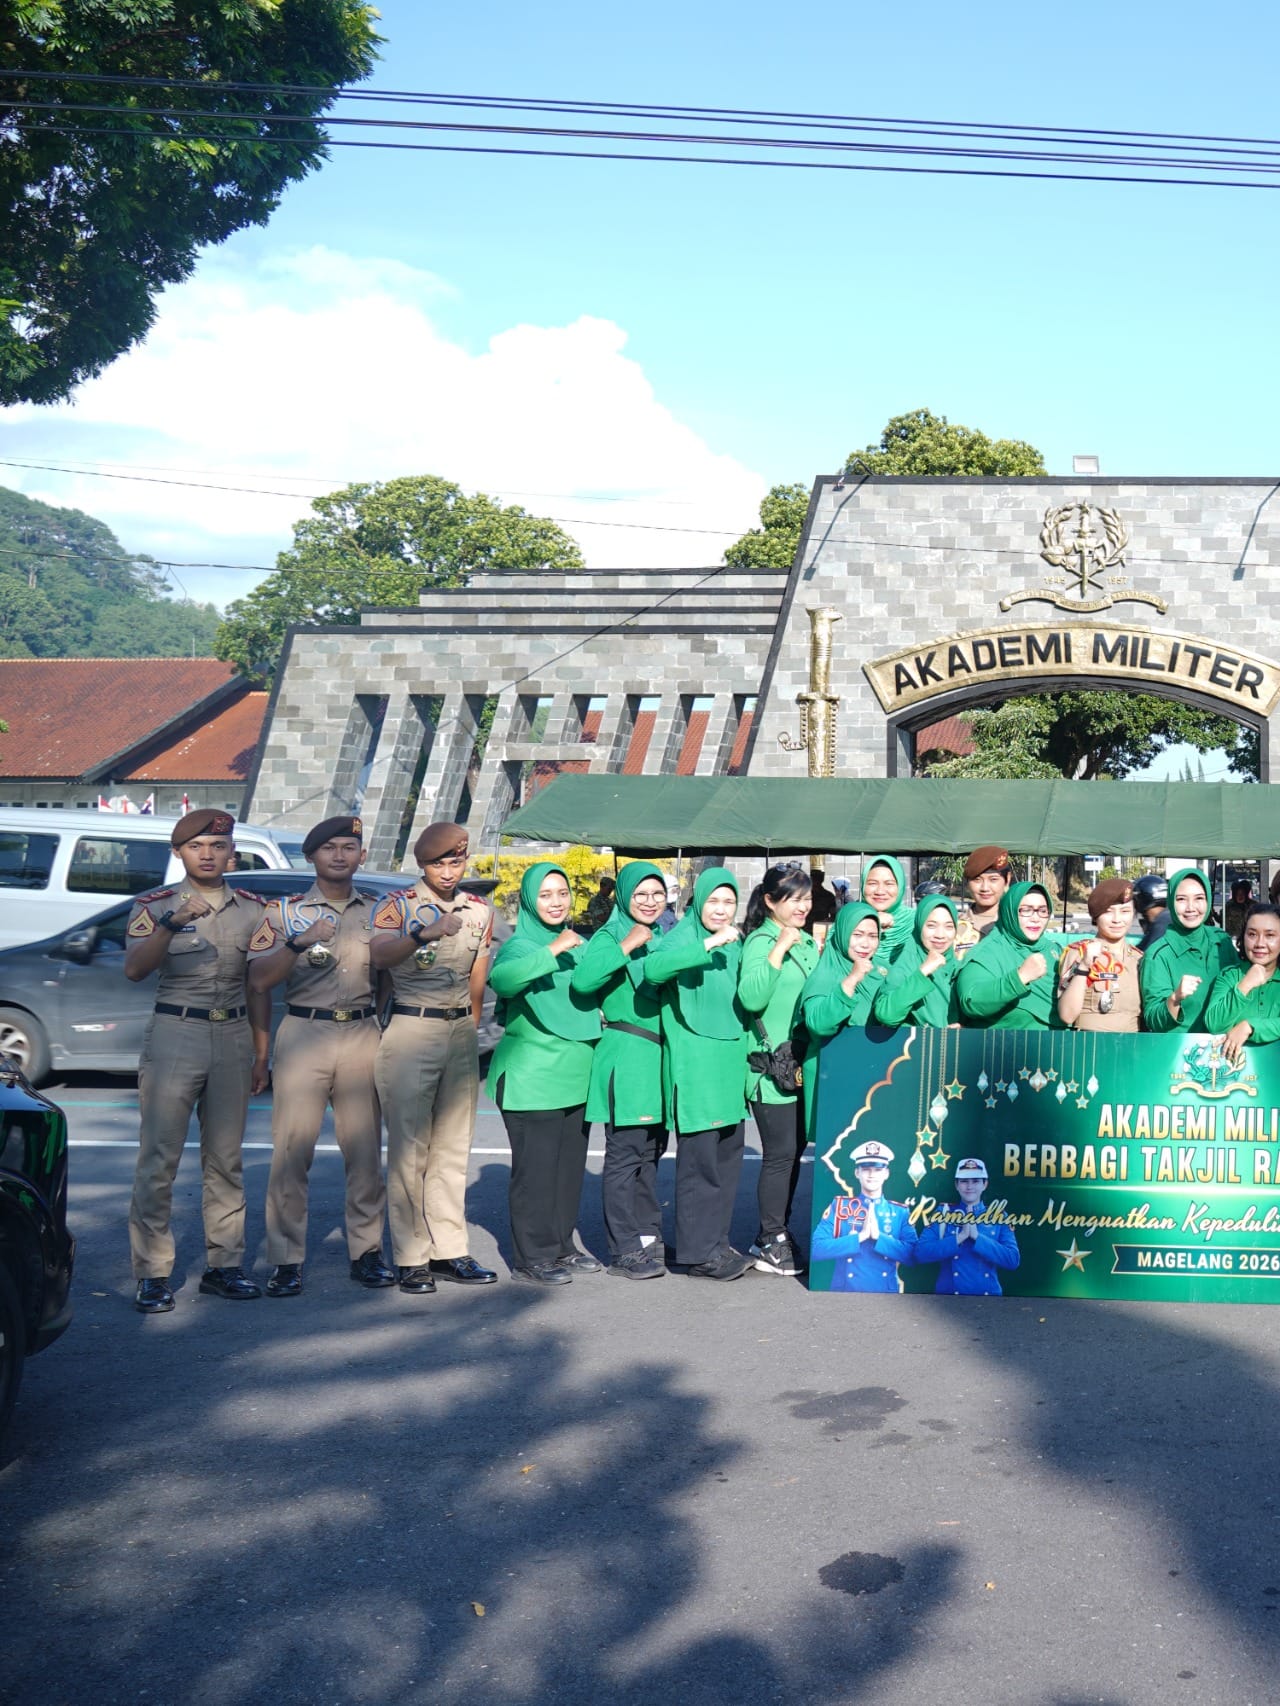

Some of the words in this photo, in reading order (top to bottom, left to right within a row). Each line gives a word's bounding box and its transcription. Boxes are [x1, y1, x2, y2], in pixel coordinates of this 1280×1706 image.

[893, 631, 1073, 697] AKADEMI
[1091, 631, 1266, 700] MILITER
[1097, 1103, 1216, 1141] AKADEMI
[1003, 1143, 1129, 1181] BERBAGI
[1141, 1146, 1242, 1184] TAKJIL
[1037, 1197, 1177, 1238] Menguatkan
[1137, 1251, 1234, 1270] MAGELANG
[1239, 1254, 1280, 1271] 2026
